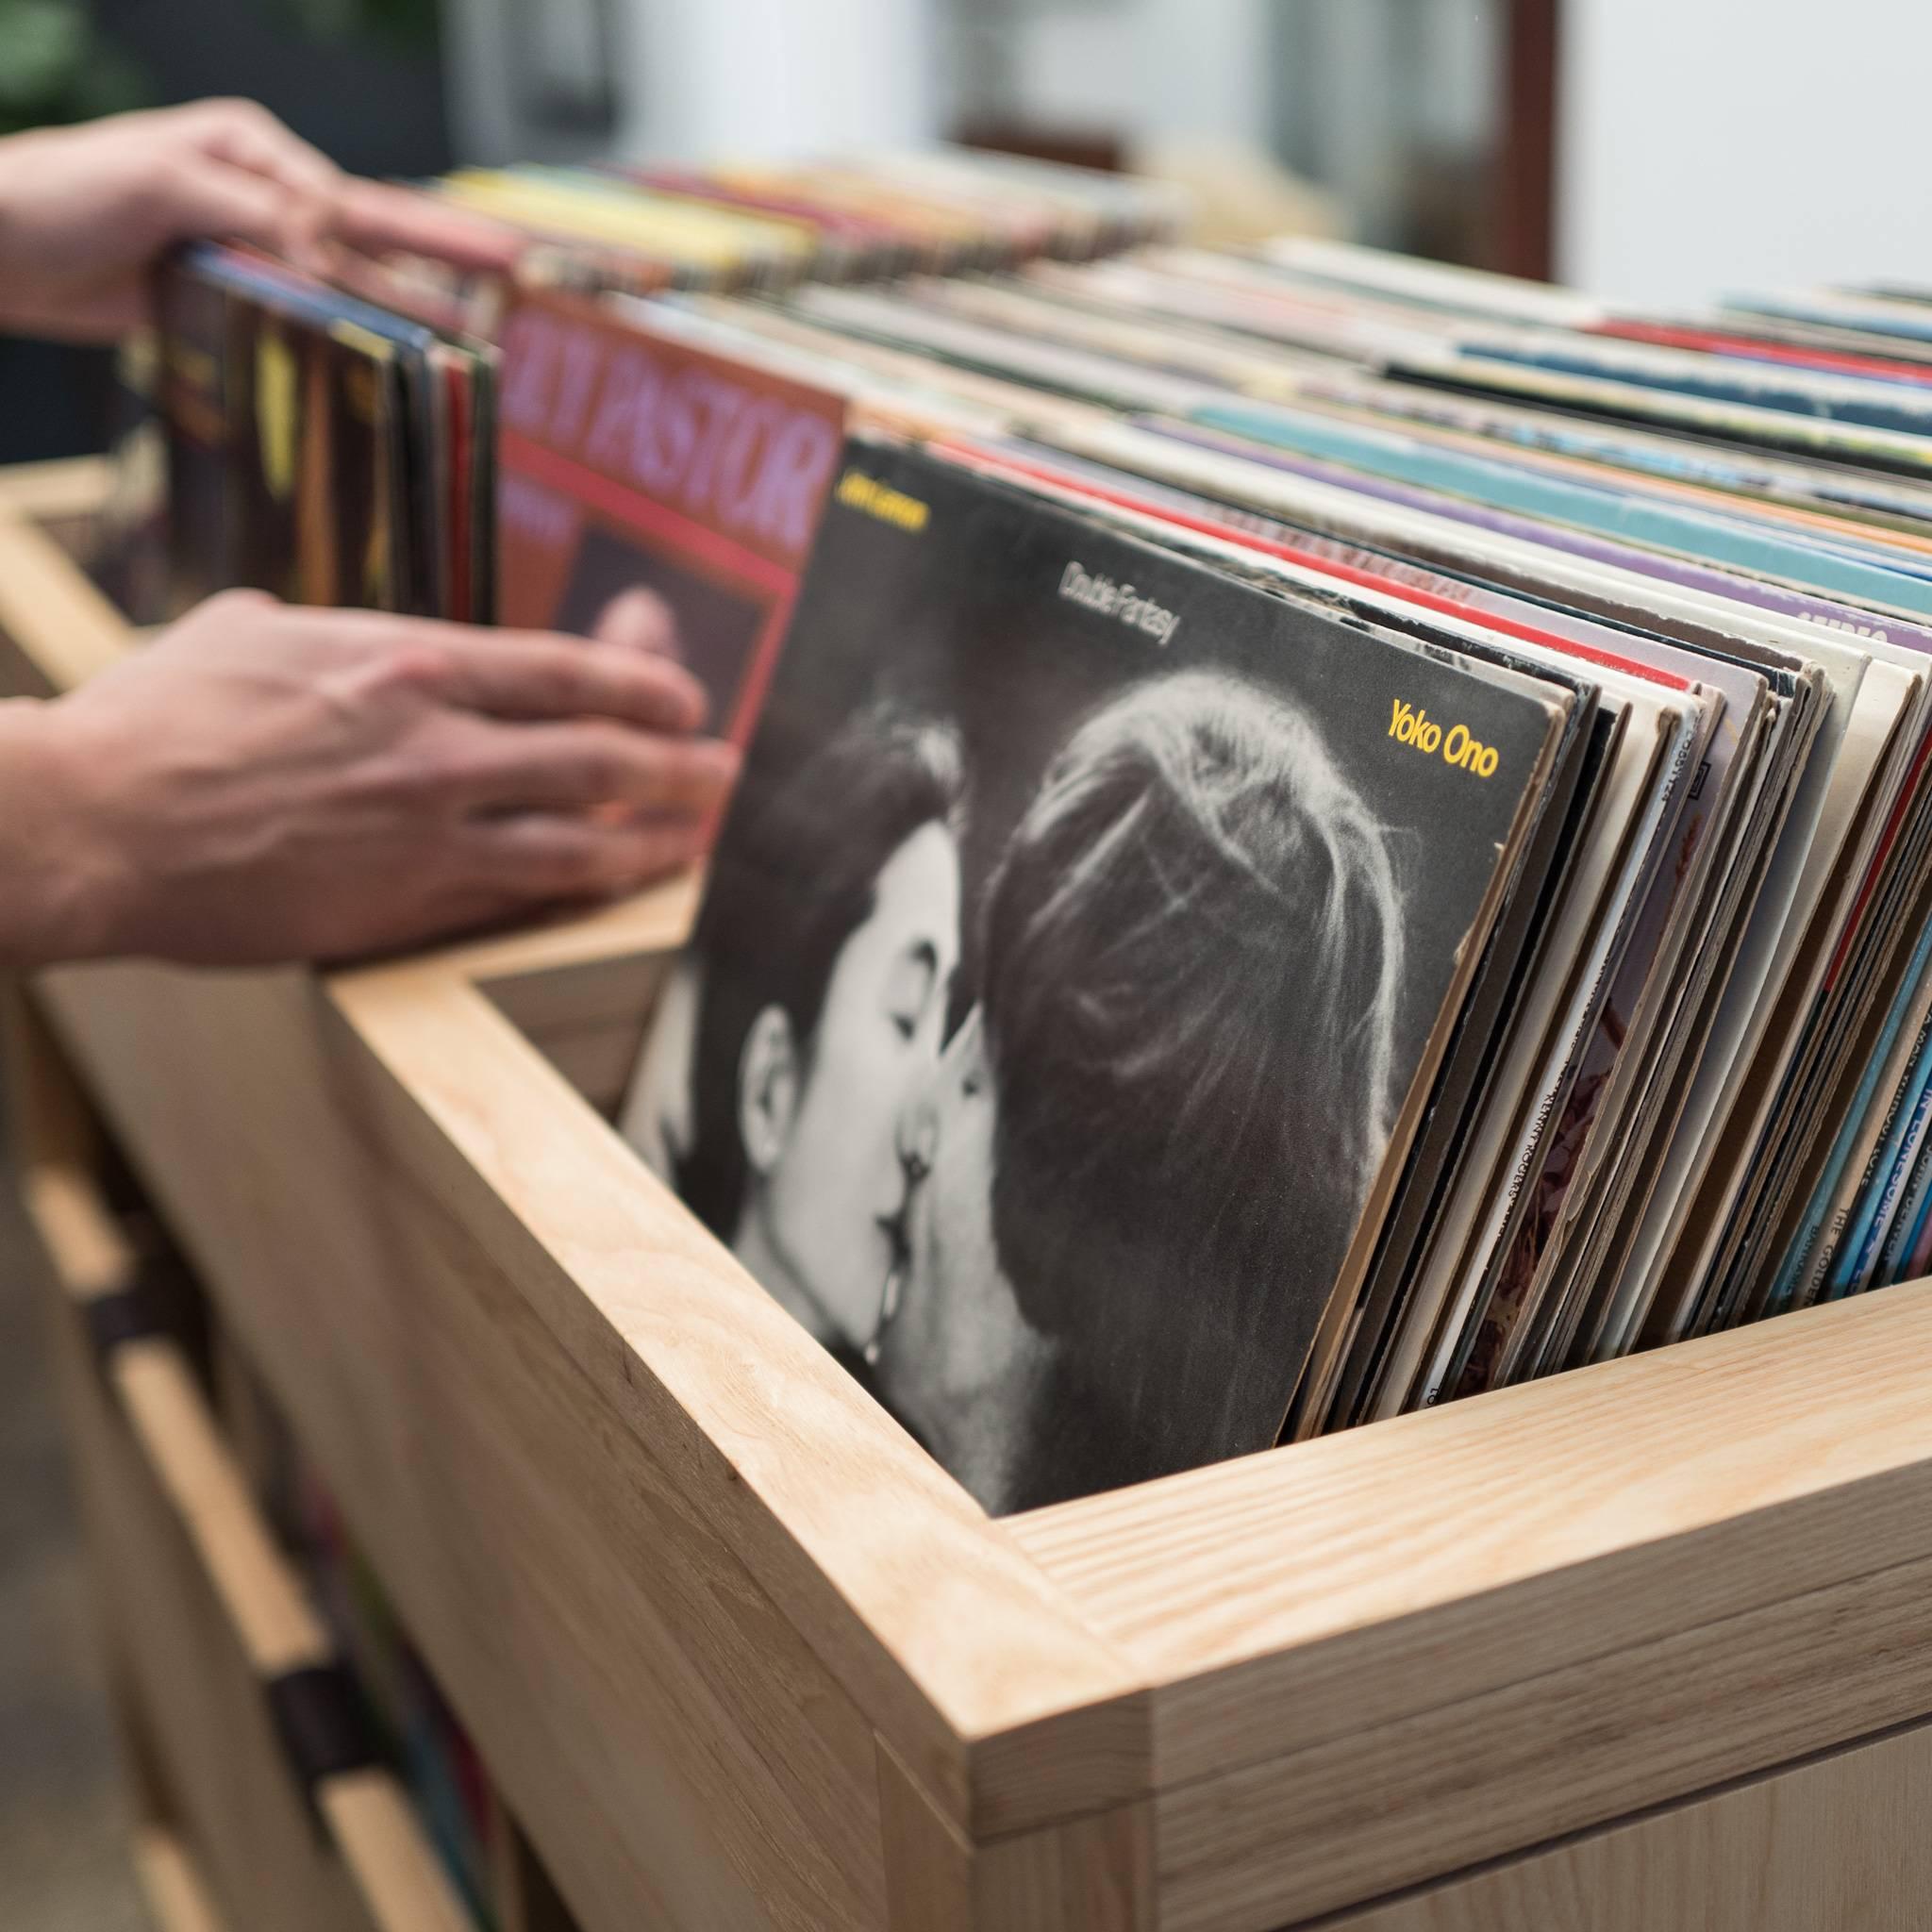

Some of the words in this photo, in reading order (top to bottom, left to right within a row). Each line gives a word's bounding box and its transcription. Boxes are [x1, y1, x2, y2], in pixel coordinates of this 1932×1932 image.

[585, 344, 834, 551] PASTOR
[1058, 560, 1118, 617] Double
[1111, 583, 1181, 645] Fantasy
[1388, 698, 1442, 754] Yoko
[1443, 724, 1499, 778] Ono
[1529, 1093, 1556, 1141] KENNY
[1507, 1144, 1535, 1199] ROGERS
[1830, 1208, 1850, 1237] THE
